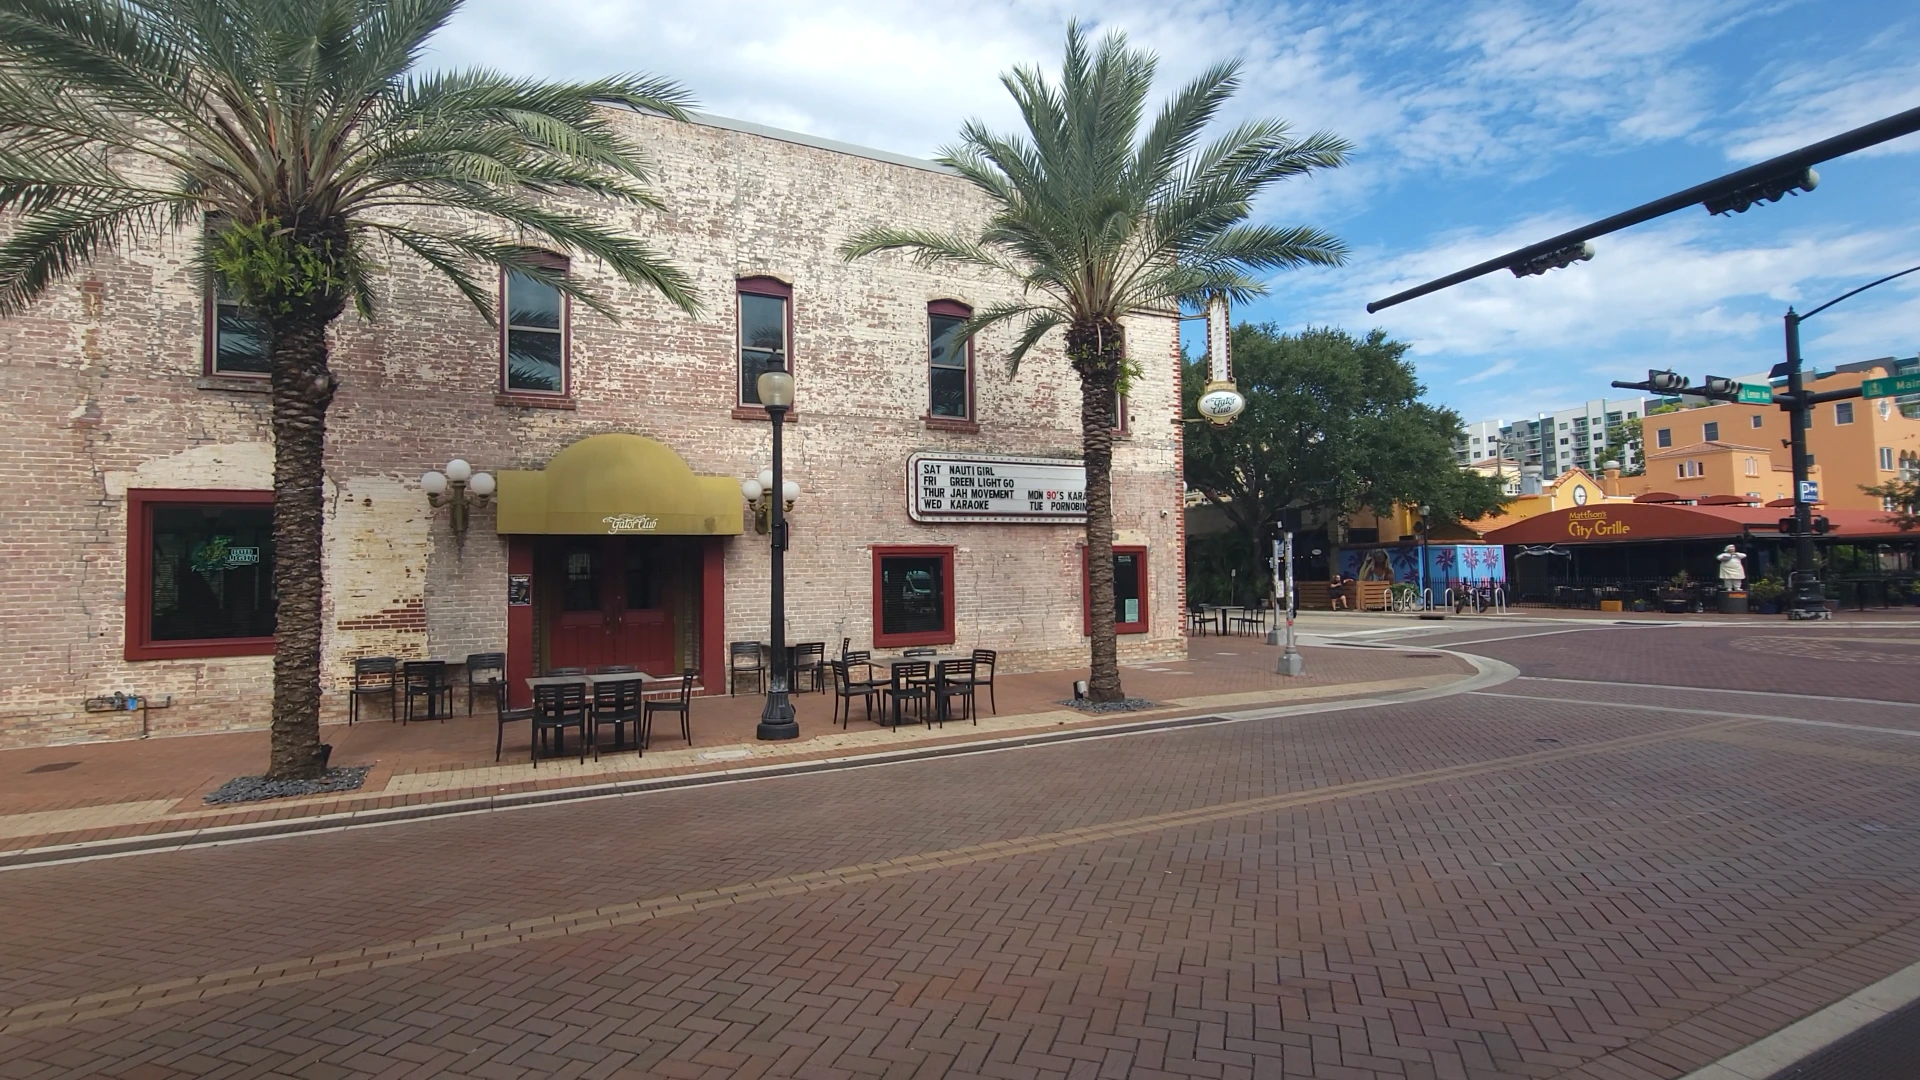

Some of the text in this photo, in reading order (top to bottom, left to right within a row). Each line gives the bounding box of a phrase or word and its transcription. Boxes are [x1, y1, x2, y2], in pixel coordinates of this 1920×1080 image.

[923, 464, 995, 476] SAT NAUTI GIRL
[923, 476, 1014, 488] FRI GREEN LIGHT GO
[923, 487, 1014, 499] THUR JAH MOVEMENT
[1028, 490, 1044, 500] MON
[1046, 490, 1064, 500] 90'S
[924, 499, 989, 510] WED KARAOKE
[1029, 501, 1043, 511] TUE
[1569, 510, 1607, 519] Mattison's
[608, 515, 637, 534] Gator
[637, 517, 658, 529] Club
[1568, 520, 1630, 539] City Grille
